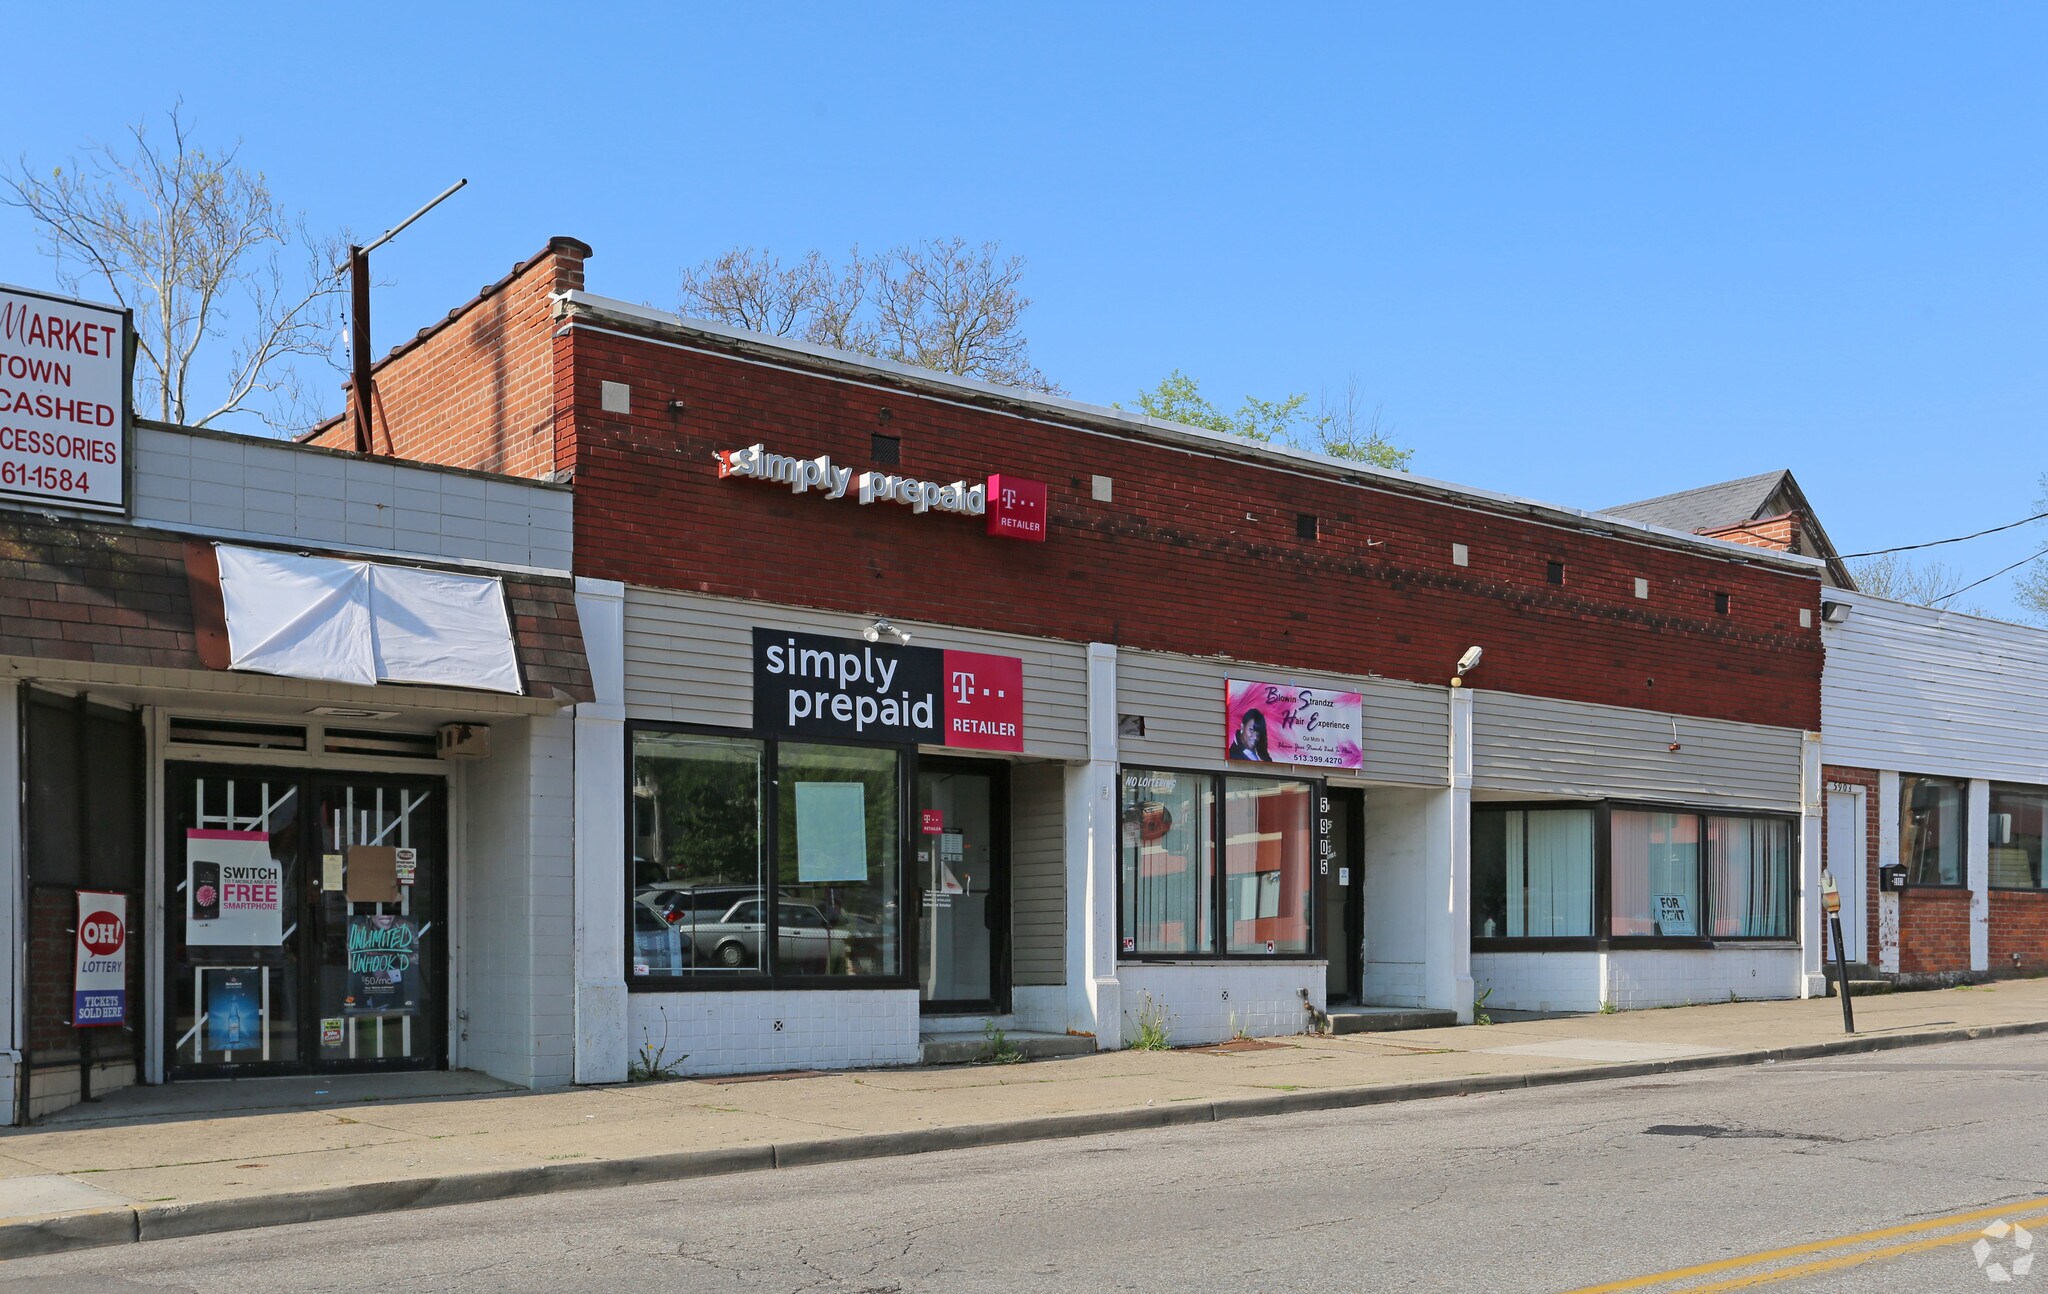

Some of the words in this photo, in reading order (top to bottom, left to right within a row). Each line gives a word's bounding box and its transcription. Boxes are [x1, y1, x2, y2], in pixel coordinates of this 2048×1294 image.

[0, 301, 117, 359] MARKET
[0, 387, 115, 428] CASHED
[729, 443, 853, 500] simply
[859, 471, 986, 515] prepaid
[1001, 517, 1041, 531] RETAILER
[766, 638, 898, 694] simply
[1298, 690, 1334, 711] Strandzz
[788, 688, 934, 732] prepaid
[953, 718, 1016, 737] RETAILER
[1281, 710, 1305, 730] Hair
[1307, 712, 1350, 732] Experience
[1294, 754, 1343, 765] 513.399.4270
[1125, 776, 1138, 787] NO
[1138, 777, 1177, 789] LOITERING
[1833, 783, 1852, 793] 5903
[223, 866, 278, 880] SWITCH
[223, 884, 278, 902] FREE
[223, 902, 278, 911] SMARTPHONE
[1660, 897, 1680, 909] FOR
[83, 920, 121, 945] OH!
[349, 923, 413, 950] UNLIMITED
[82, 960, 123, 974] LOTTERY
[84, 996, 119, 1008] TICKETS
[79, 1008, 102, 1019] SOLD
[102, 1007, 123, 1018] HERE
